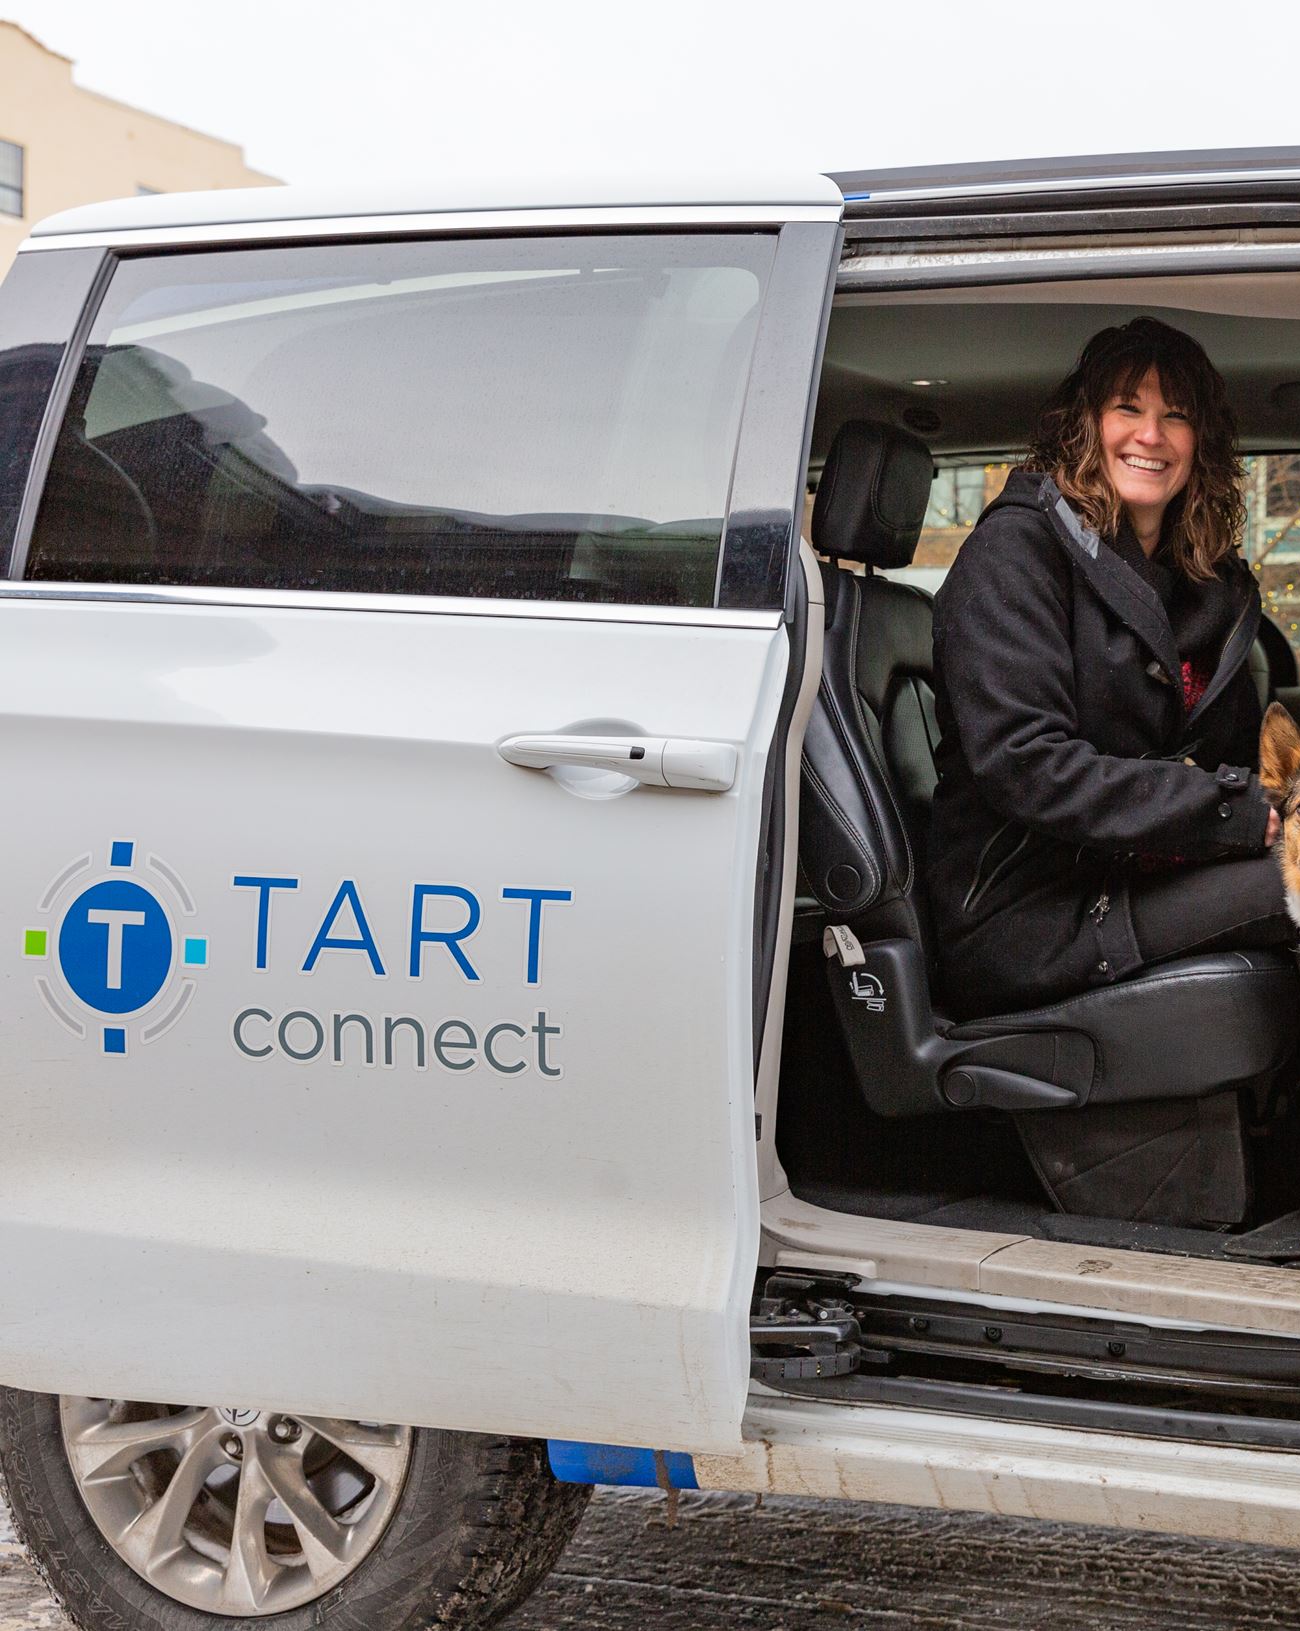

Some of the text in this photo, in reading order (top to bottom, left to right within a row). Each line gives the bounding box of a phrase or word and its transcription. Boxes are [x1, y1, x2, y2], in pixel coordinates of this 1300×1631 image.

[88, 909, 146, 989] T
[233, 875, 573, 984] TART
[233, 1008, 561, 1077] connect
